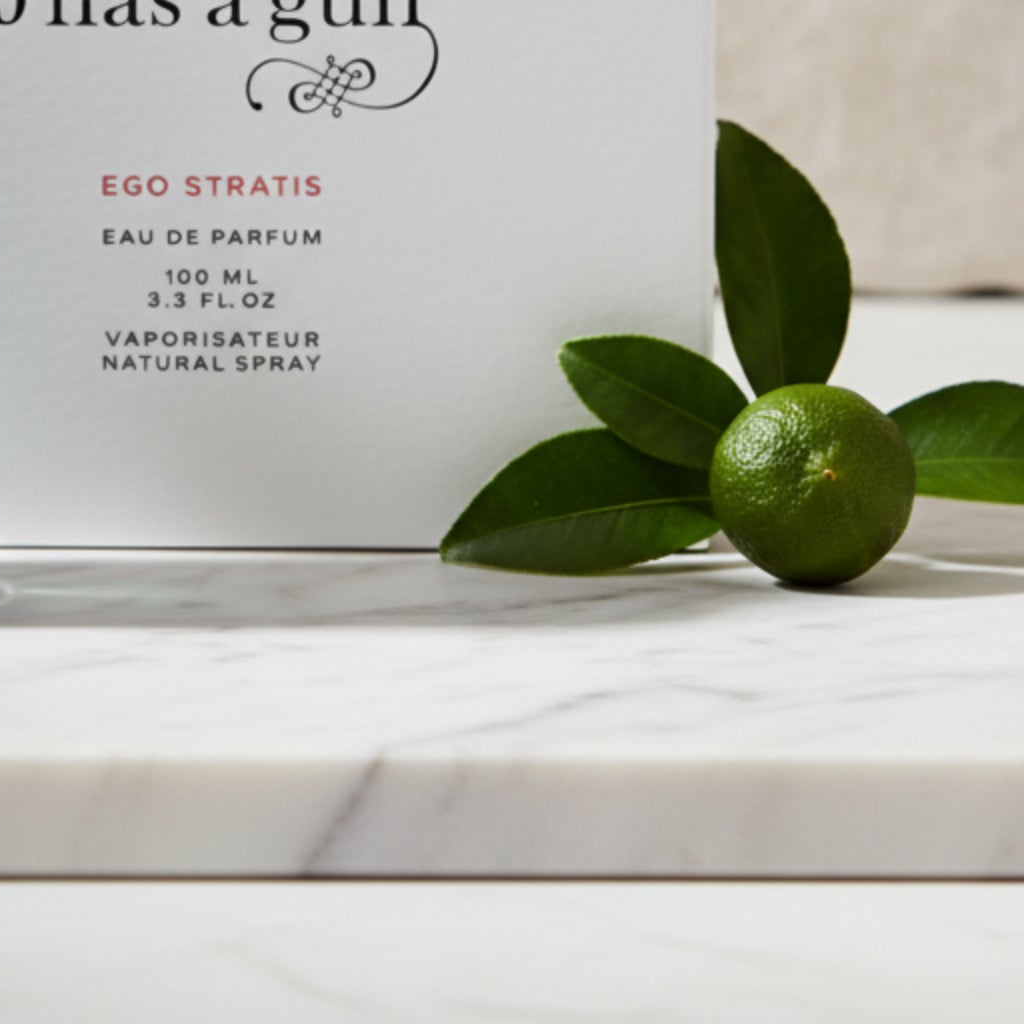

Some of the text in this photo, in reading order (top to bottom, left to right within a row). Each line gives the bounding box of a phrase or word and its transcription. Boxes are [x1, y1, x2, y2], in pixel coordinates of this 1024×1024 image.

[101, 175, 322, 197] EGO STRATIS
[102, 229, 322, 246] EAU DE PARFUM
[165, 269, 258, 285] 100 ML
[147, 291, 187, 308] 3.3
[105, 331, 320, 348] VAPORISATEUR
[102, 355, 321, 372] NATURAL SPRAY
